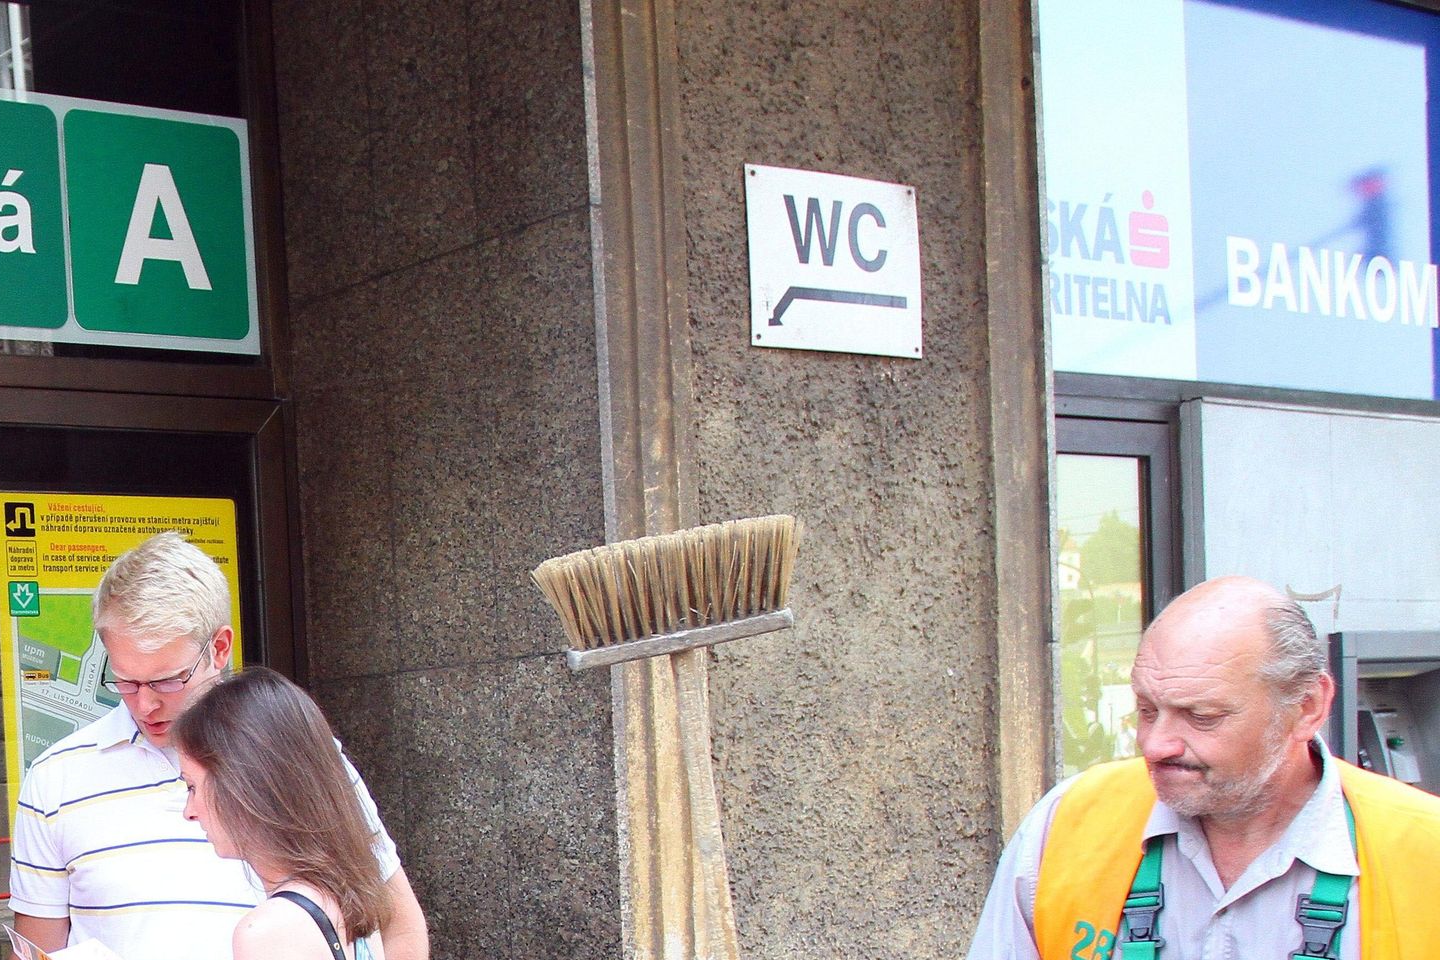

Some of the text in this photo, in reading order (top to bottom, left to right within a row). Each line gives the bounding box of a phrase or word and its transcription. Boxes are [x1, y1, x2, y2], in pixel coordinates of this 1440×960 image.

[114, 162, 213, 291] A
[782, 193, 888, 273] WC
[109, 516, 137, 524] provozu
[74, 524, 103, 533] dopravu
[8, 546, 35, 554] Náhradní
[50, 542, 66, 552] Dear
[10, 555, 33, 564] doprava
[77, 554, 101, 562] service
[43, 564, 73, 573] transport
[74, 564, 98, 572] service
[24, 644, 45, 658] upm
[53, 692, 94, 712] LISTOPADU
